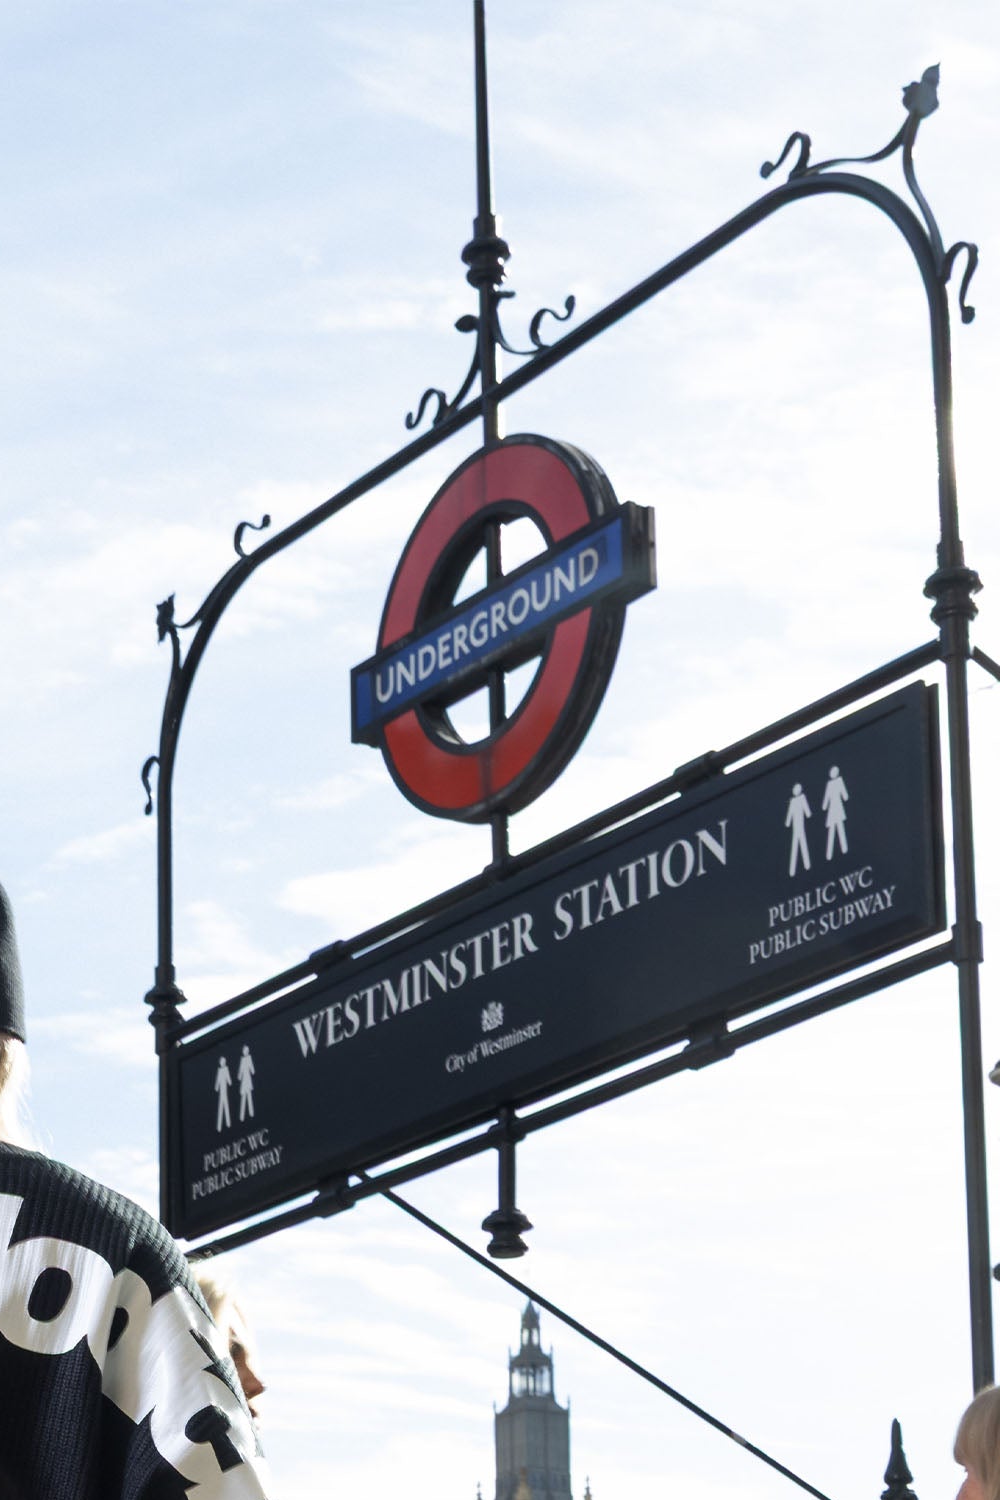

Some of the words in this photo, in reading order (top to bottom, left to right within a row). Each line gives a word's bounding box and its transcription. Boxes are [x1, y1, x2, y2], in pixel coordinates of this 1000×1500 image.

[376, 547, 600, 703] UNDERGROUND
[749, 919, 817, 965] PUBLIC
[819, 885, 896, 936] SUBWAY
[768, 882, 836, 928] PUBLIC
[839, 866, 873, 896] WC
[292, 912, 539, 1059] WESTMINSTER
[553, 819, 728, 941] STATION
[445, 1054, 466, 1073] City
[467, 1042, 480, 1064] of
[480, 1021, 543, 1058] Westminster
[192, 1166, 233, 1200] PUBLIC
[234, 1145, 283, 1182] SUBWAY
[203, 1138, 247, 1172] PUBLIC
[247, 1128, 269, 1151] WC
